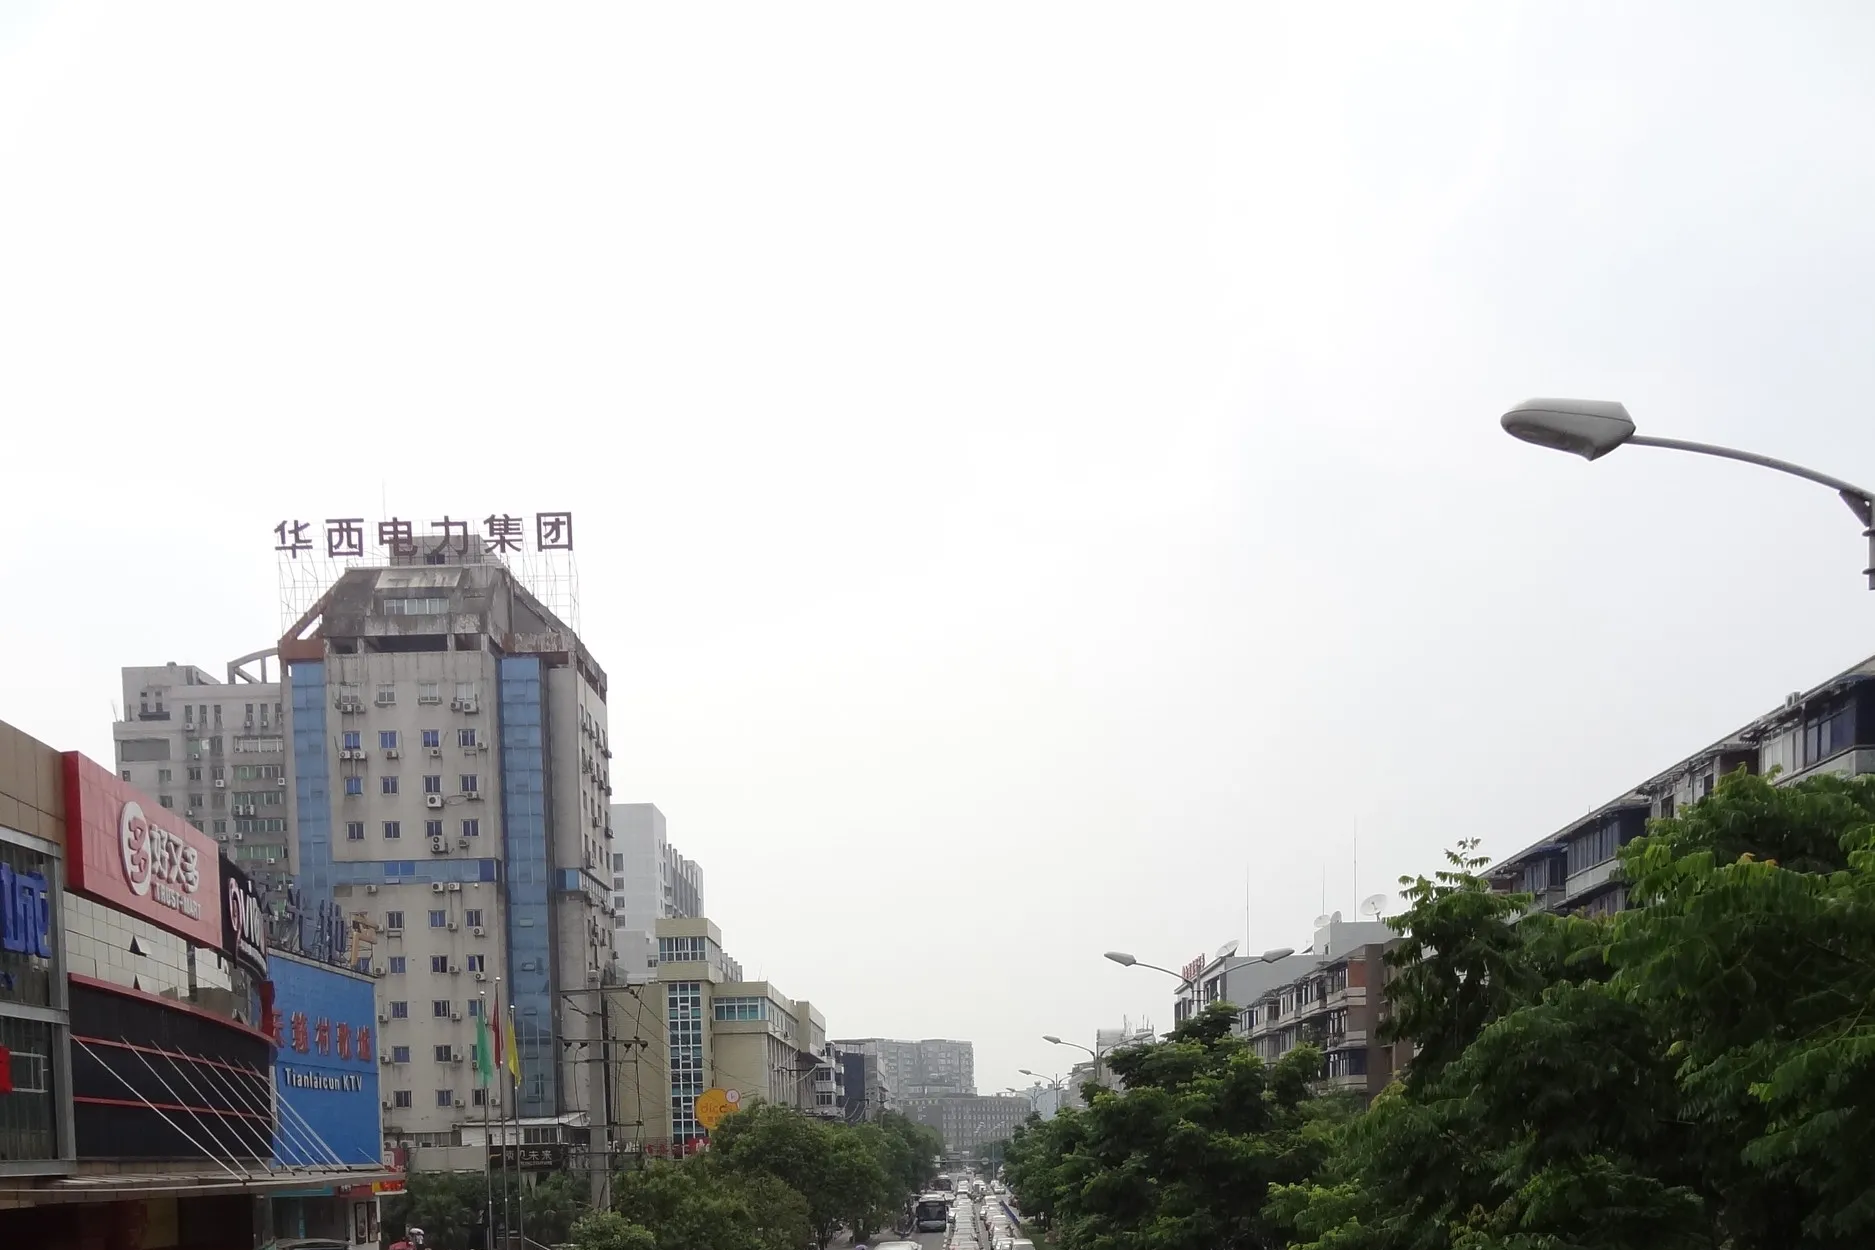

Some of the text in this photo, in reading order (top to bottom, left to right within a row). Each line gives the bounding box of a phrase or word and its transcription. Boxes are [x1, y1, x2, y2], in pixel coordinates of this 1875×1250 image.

[274, 511, 574, 559] 华西电力集团
[284, 1067, 363, 1091] Tianlaicun KTV
